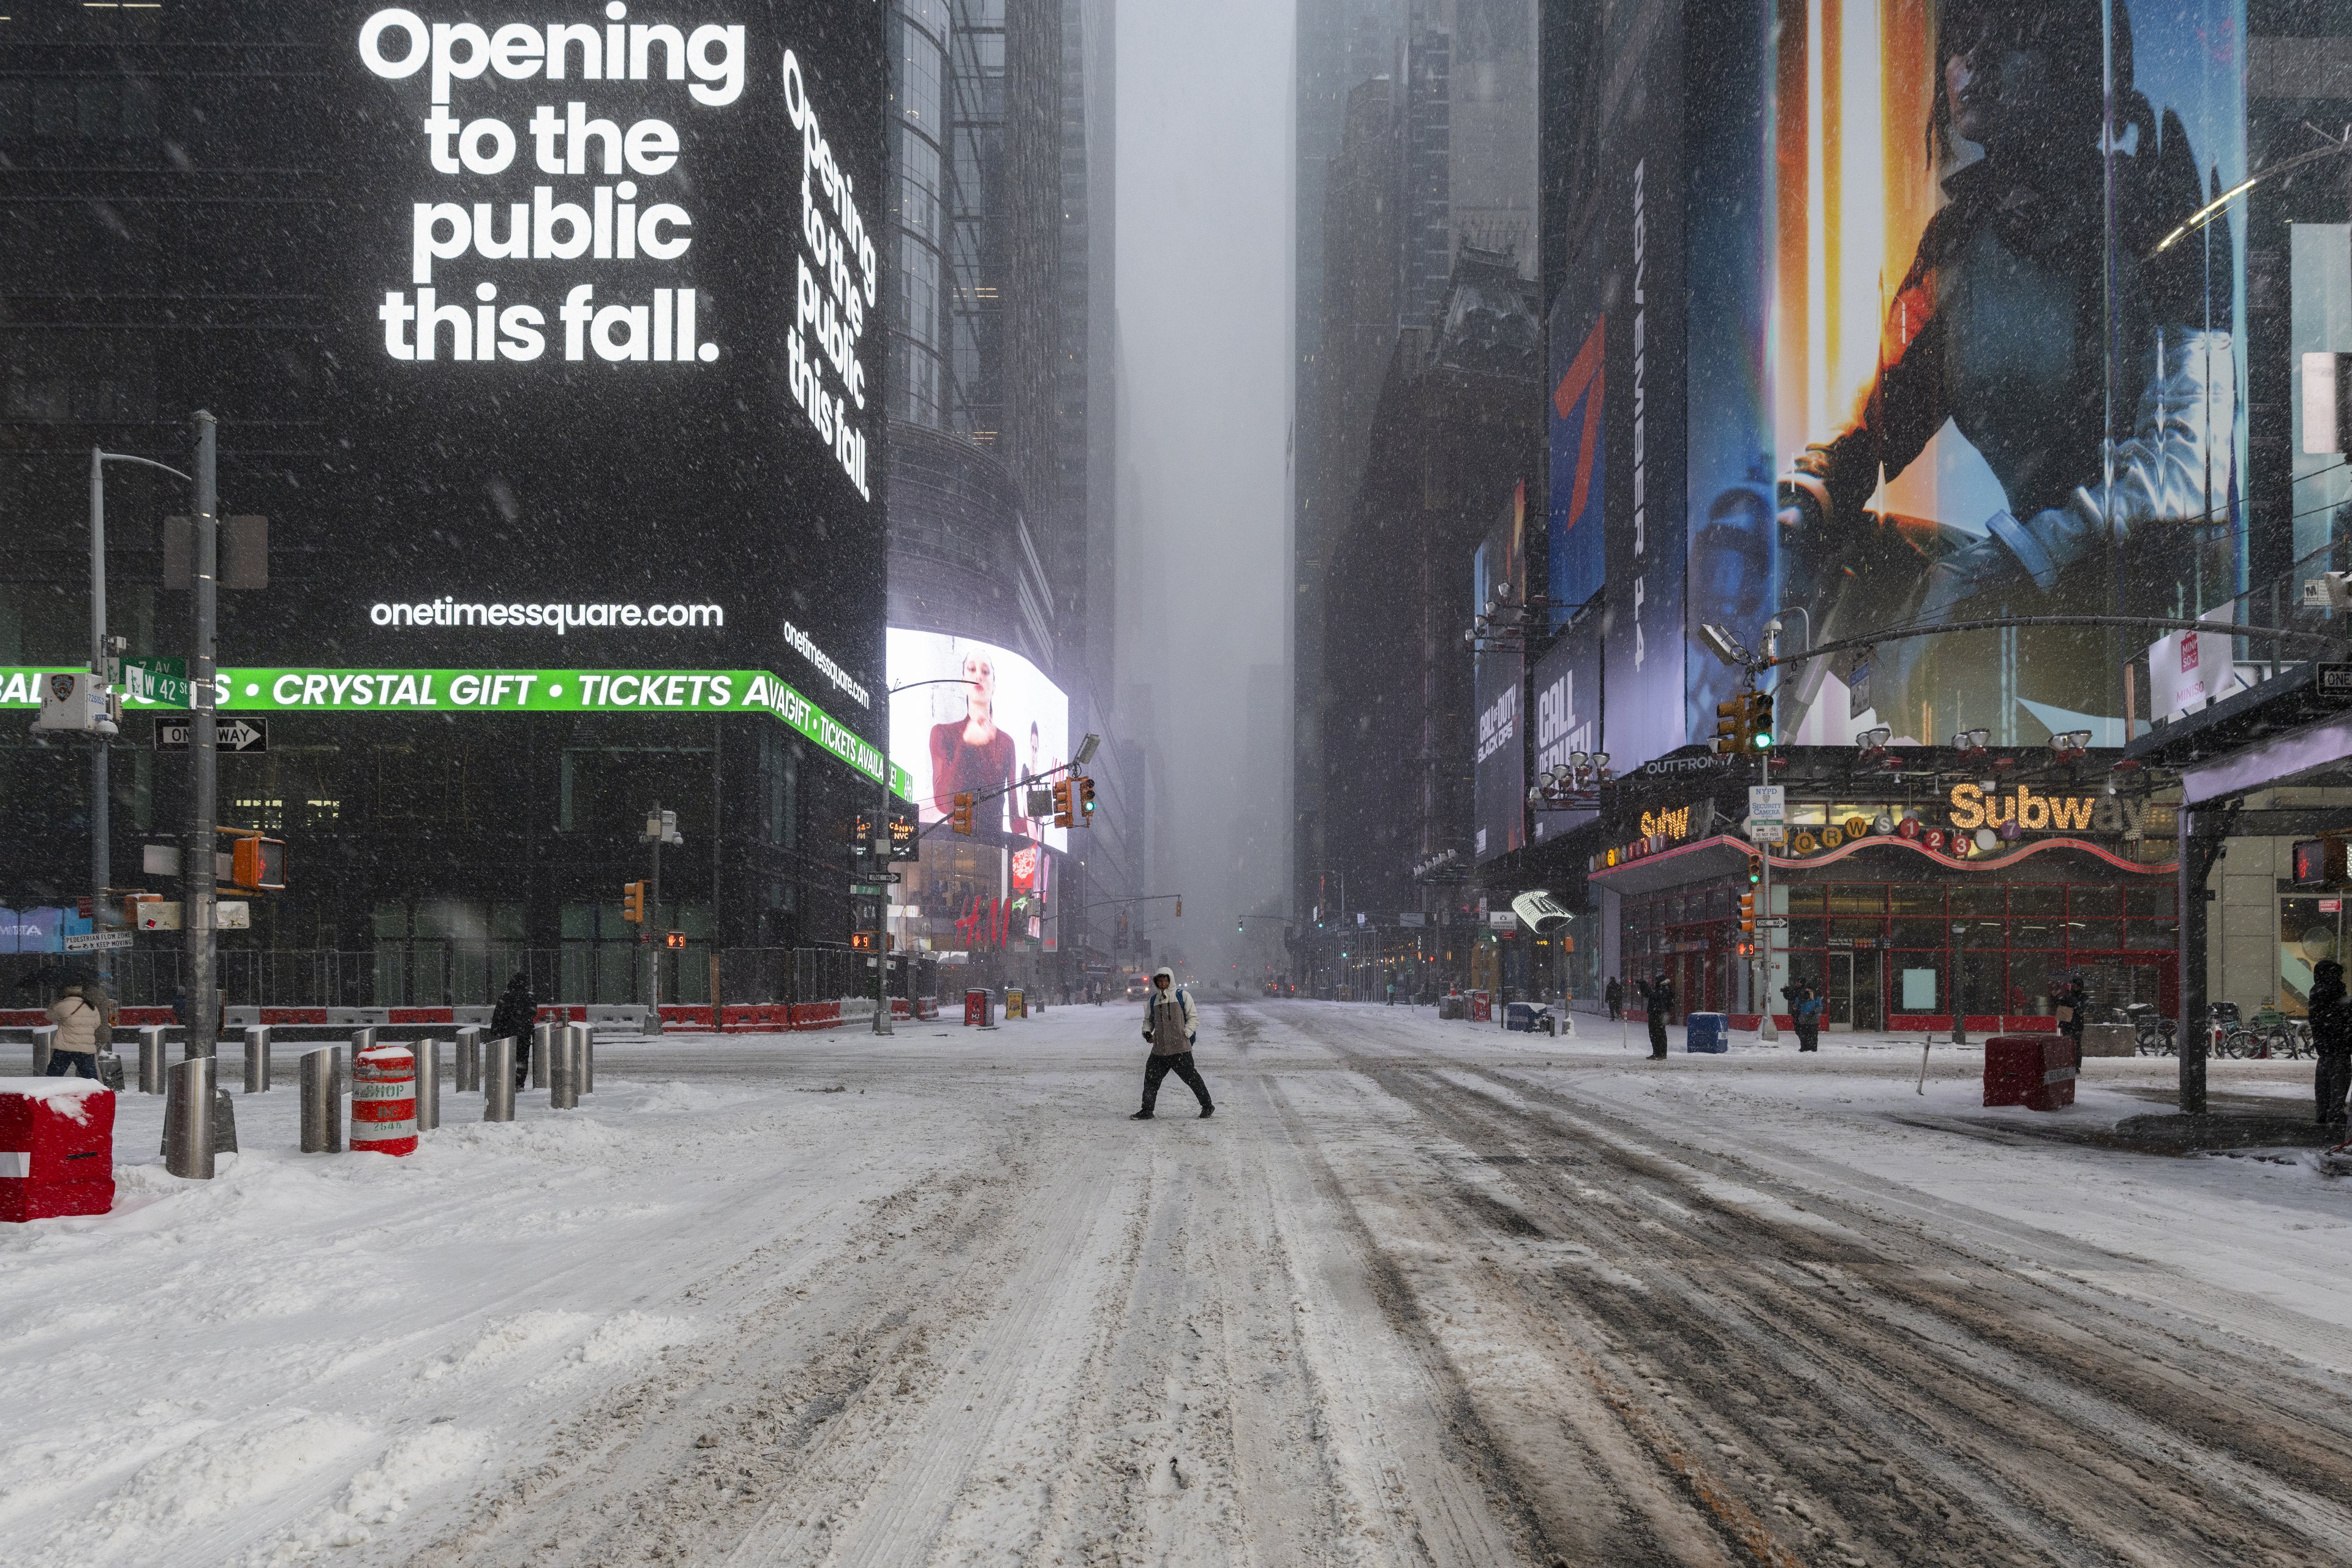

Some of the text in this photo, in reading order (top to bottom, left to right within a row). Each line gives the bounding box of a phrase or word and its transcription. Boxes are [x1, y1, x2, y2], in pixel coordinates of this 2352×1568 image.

[359, 1, 745, 106] Opening
[424, 102, 679, 175] to the
[783, 49, 876, 307] Opening
[413, 181, 692, 283] public
[802, 179, 863, 337] to the
[380, 282, 719, 361] this fall.
[797, 254, 865, 409] public
[788, 325, 870, 505] this fall.
[1635, 157, 1644, 673] NOVEMBER 14
[371, 596, 723, 635] onetimessquare.com
[145, 674, 155, 696] W
[160, 679, 176, 701] 42
[179, 682, 187, 695] St
[784, 621, 869, 709] onetimessquare.com
[2328, 673, 2351, 685] ONE
[88, 694, 104, 705] 726152
[273, 674, 437, 705] CRYSTAL
[450, 675, 538, 705] GIFT
[579, 676, 732, 706] TICKETS
[1480, 706, 1494, 744] CALL
[1498, 683, 1516, 728] DUTY
[1539, 669, 1575, 749] CALL
[2176, 681, 2204, 703] MINISO
[217, 729, 250, 742] WAY
[821, 715, 856, 762] TICKETS
[1478, 734, 1498, 764] BLACK
[1499, 720, 1513, 747] OPS
[1798, 836, 1811, 849] Q
[1826, 831, 1838, 843] R
[1849, 821, 1865, 835] W
[1879, 817, 1890, 831] S
[1931, 833, 1940, 846] 2
[1956, 839, 1967, 853] 3
[2007, 823, 2016, 836] 7
[1950, 783, 2150, 841] Subway
[66, 935, 100, 943] PEDESTRIAN
[679, 936, 684, 946] 9
[864, 937, 868, 947] 9
[954, 895, 1011, 949] H&M
[1749, 944, 1754, 954] 9
[366, 1085, 404, 1098] SHOP
